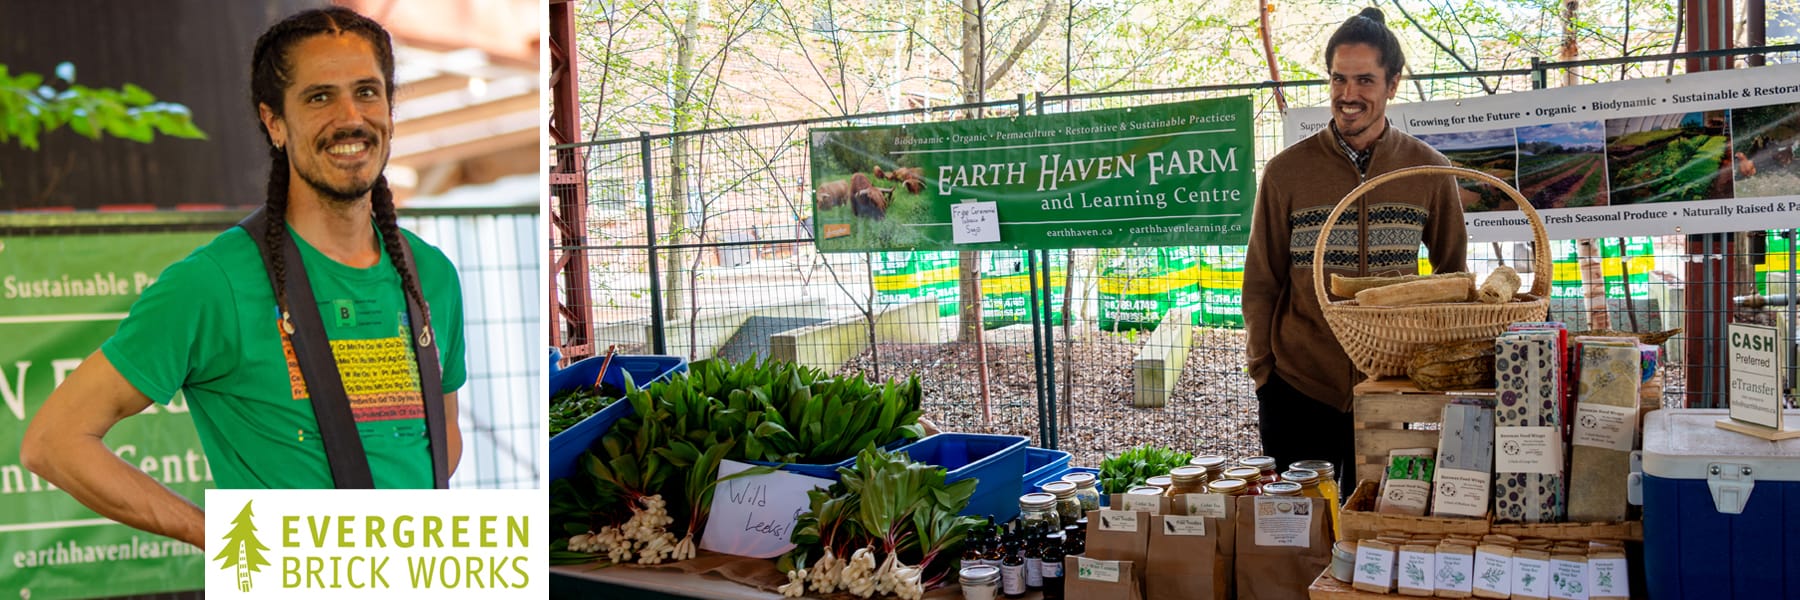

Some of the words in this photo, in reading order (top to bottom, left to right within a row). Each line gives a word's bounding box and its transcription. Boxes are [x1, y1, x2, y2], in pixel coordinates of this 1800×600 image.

[1409, 116, 1448, 130] Growing
[1451, 114, 1464, 125] for
[1466, 113, 1484, 125] the
[1486, 110, 1521, 123] Future
[1535, 103, 1577, 118] Organic
[1592, 96, 1656, 114] Biodynamic
[1672, 89, 1739, 104] Sustainable
[1741, 87, 1751, 97] &
[1753, 83, 1800, 96] Restora
[894, 134, 943, 146] Biodynamic
[952, 132, 987, 144] Organic
[996, 128, 1056, 141] Permaculture
[1065, 123, 1118, 136] Restorative
[1119, 121, 1128, 131] &
[1129, 116, 1187, 130] Sustainable
[1189, 112, 1236, 124] Practices
[1300, 121, 1328, 132] Suppo
[938, 162, 1027, 196] EARTH
[1037, 153, 1136, 192] HAVEN
[1148, 146, 1238, 186] FARM
[1041, 194, 1073, 211] and
[1081, 189, 1168, 213] Learning
[1174, 185, 1241, 204] Centre
[1545, 211, 1572, 224] Fresh
[1574, 210, 1621, 223] Seasonal
[1623, 208, 1668, 221] Produce
[1682, 204, 1734, 220] Naturally
[1736, 202, 1774, 215] Raised
[1777, 202, 1787, 213] &
[1046, 225, 1114, 238] earthhaven.ca
[1129, 222, 1242, 236] earthhavenlearning.ca
[4, 272, 129, 299] Sustainable
[340, 307, 350, 320] B
[1732, 332, 1774, 352] CASH
[1736, 353, 1770, 368] Preferred
[1732, 378, 1775, 397] eTransfer
[729, 480, 767, 507] Wild
